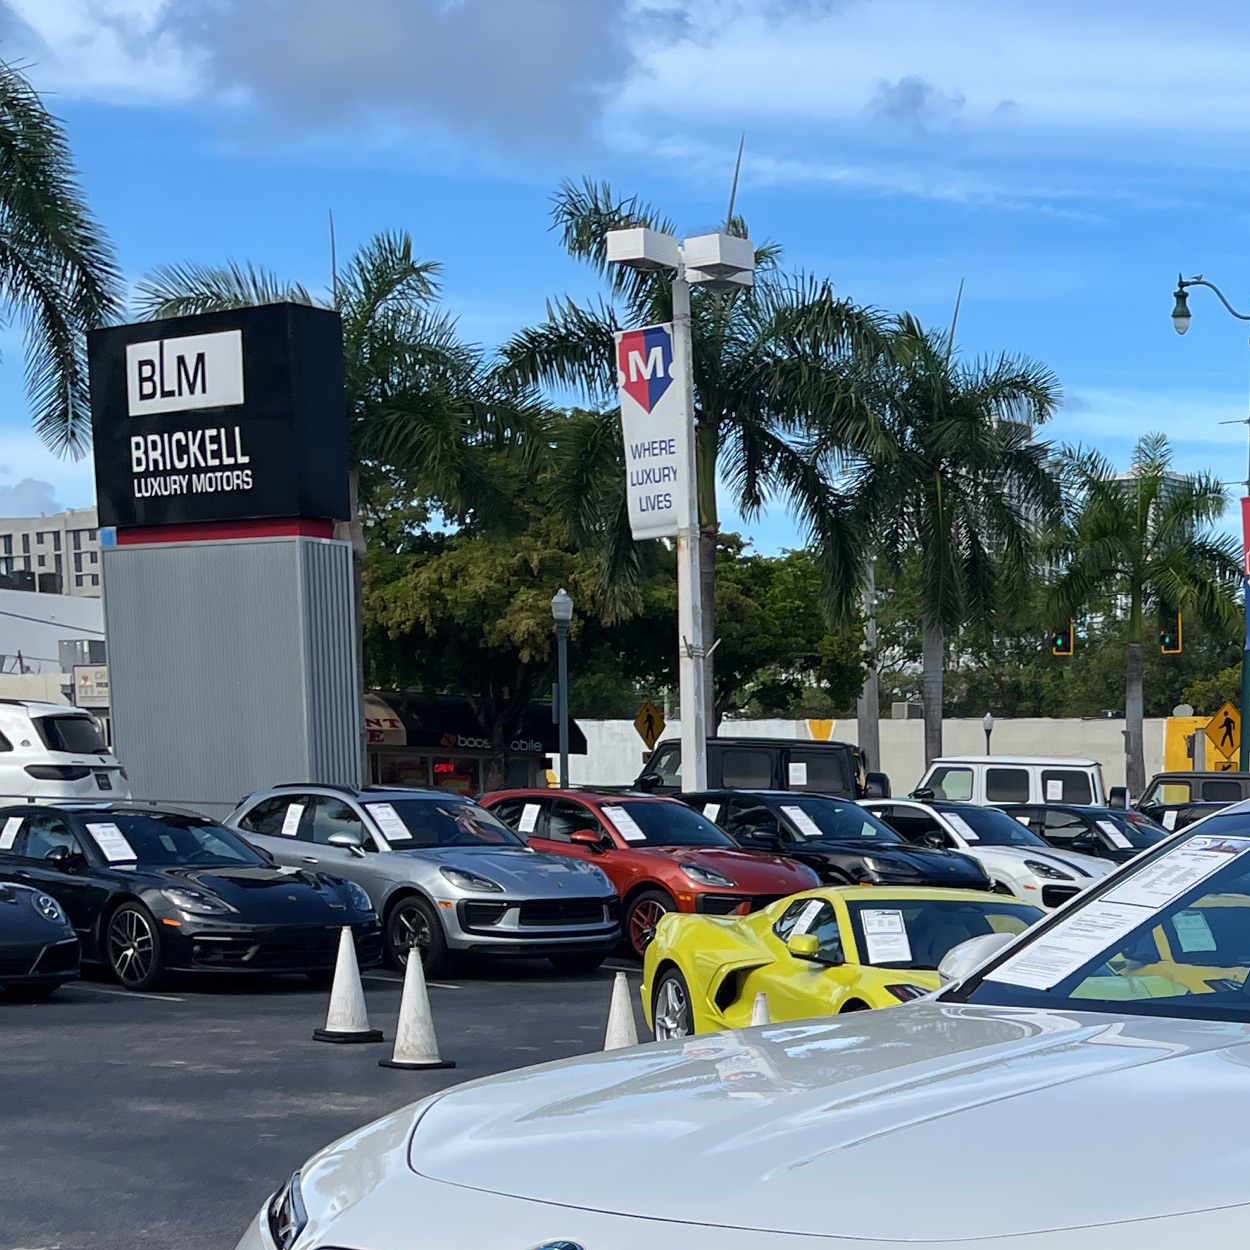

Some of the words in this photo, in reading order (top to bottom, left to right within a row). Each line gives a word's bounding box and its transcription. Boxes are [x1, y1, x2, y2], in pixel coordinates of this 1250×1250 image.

[138, 340, 207, 401] BLM
[628, 346, 664, 382] M
[131, 426, 250, 473] BRICKELL
[630, 438, 676, 460] WHERE
[134, 474, 188, 498] LUXURY
[192, 469, 253, 493] MOTORS
[630, 465, 678, 487] LUXURY
[639, 493, 672, 512] LIVES
[457, 734, 491, 749] boos
[434, 764, 454, 773] OPEN
